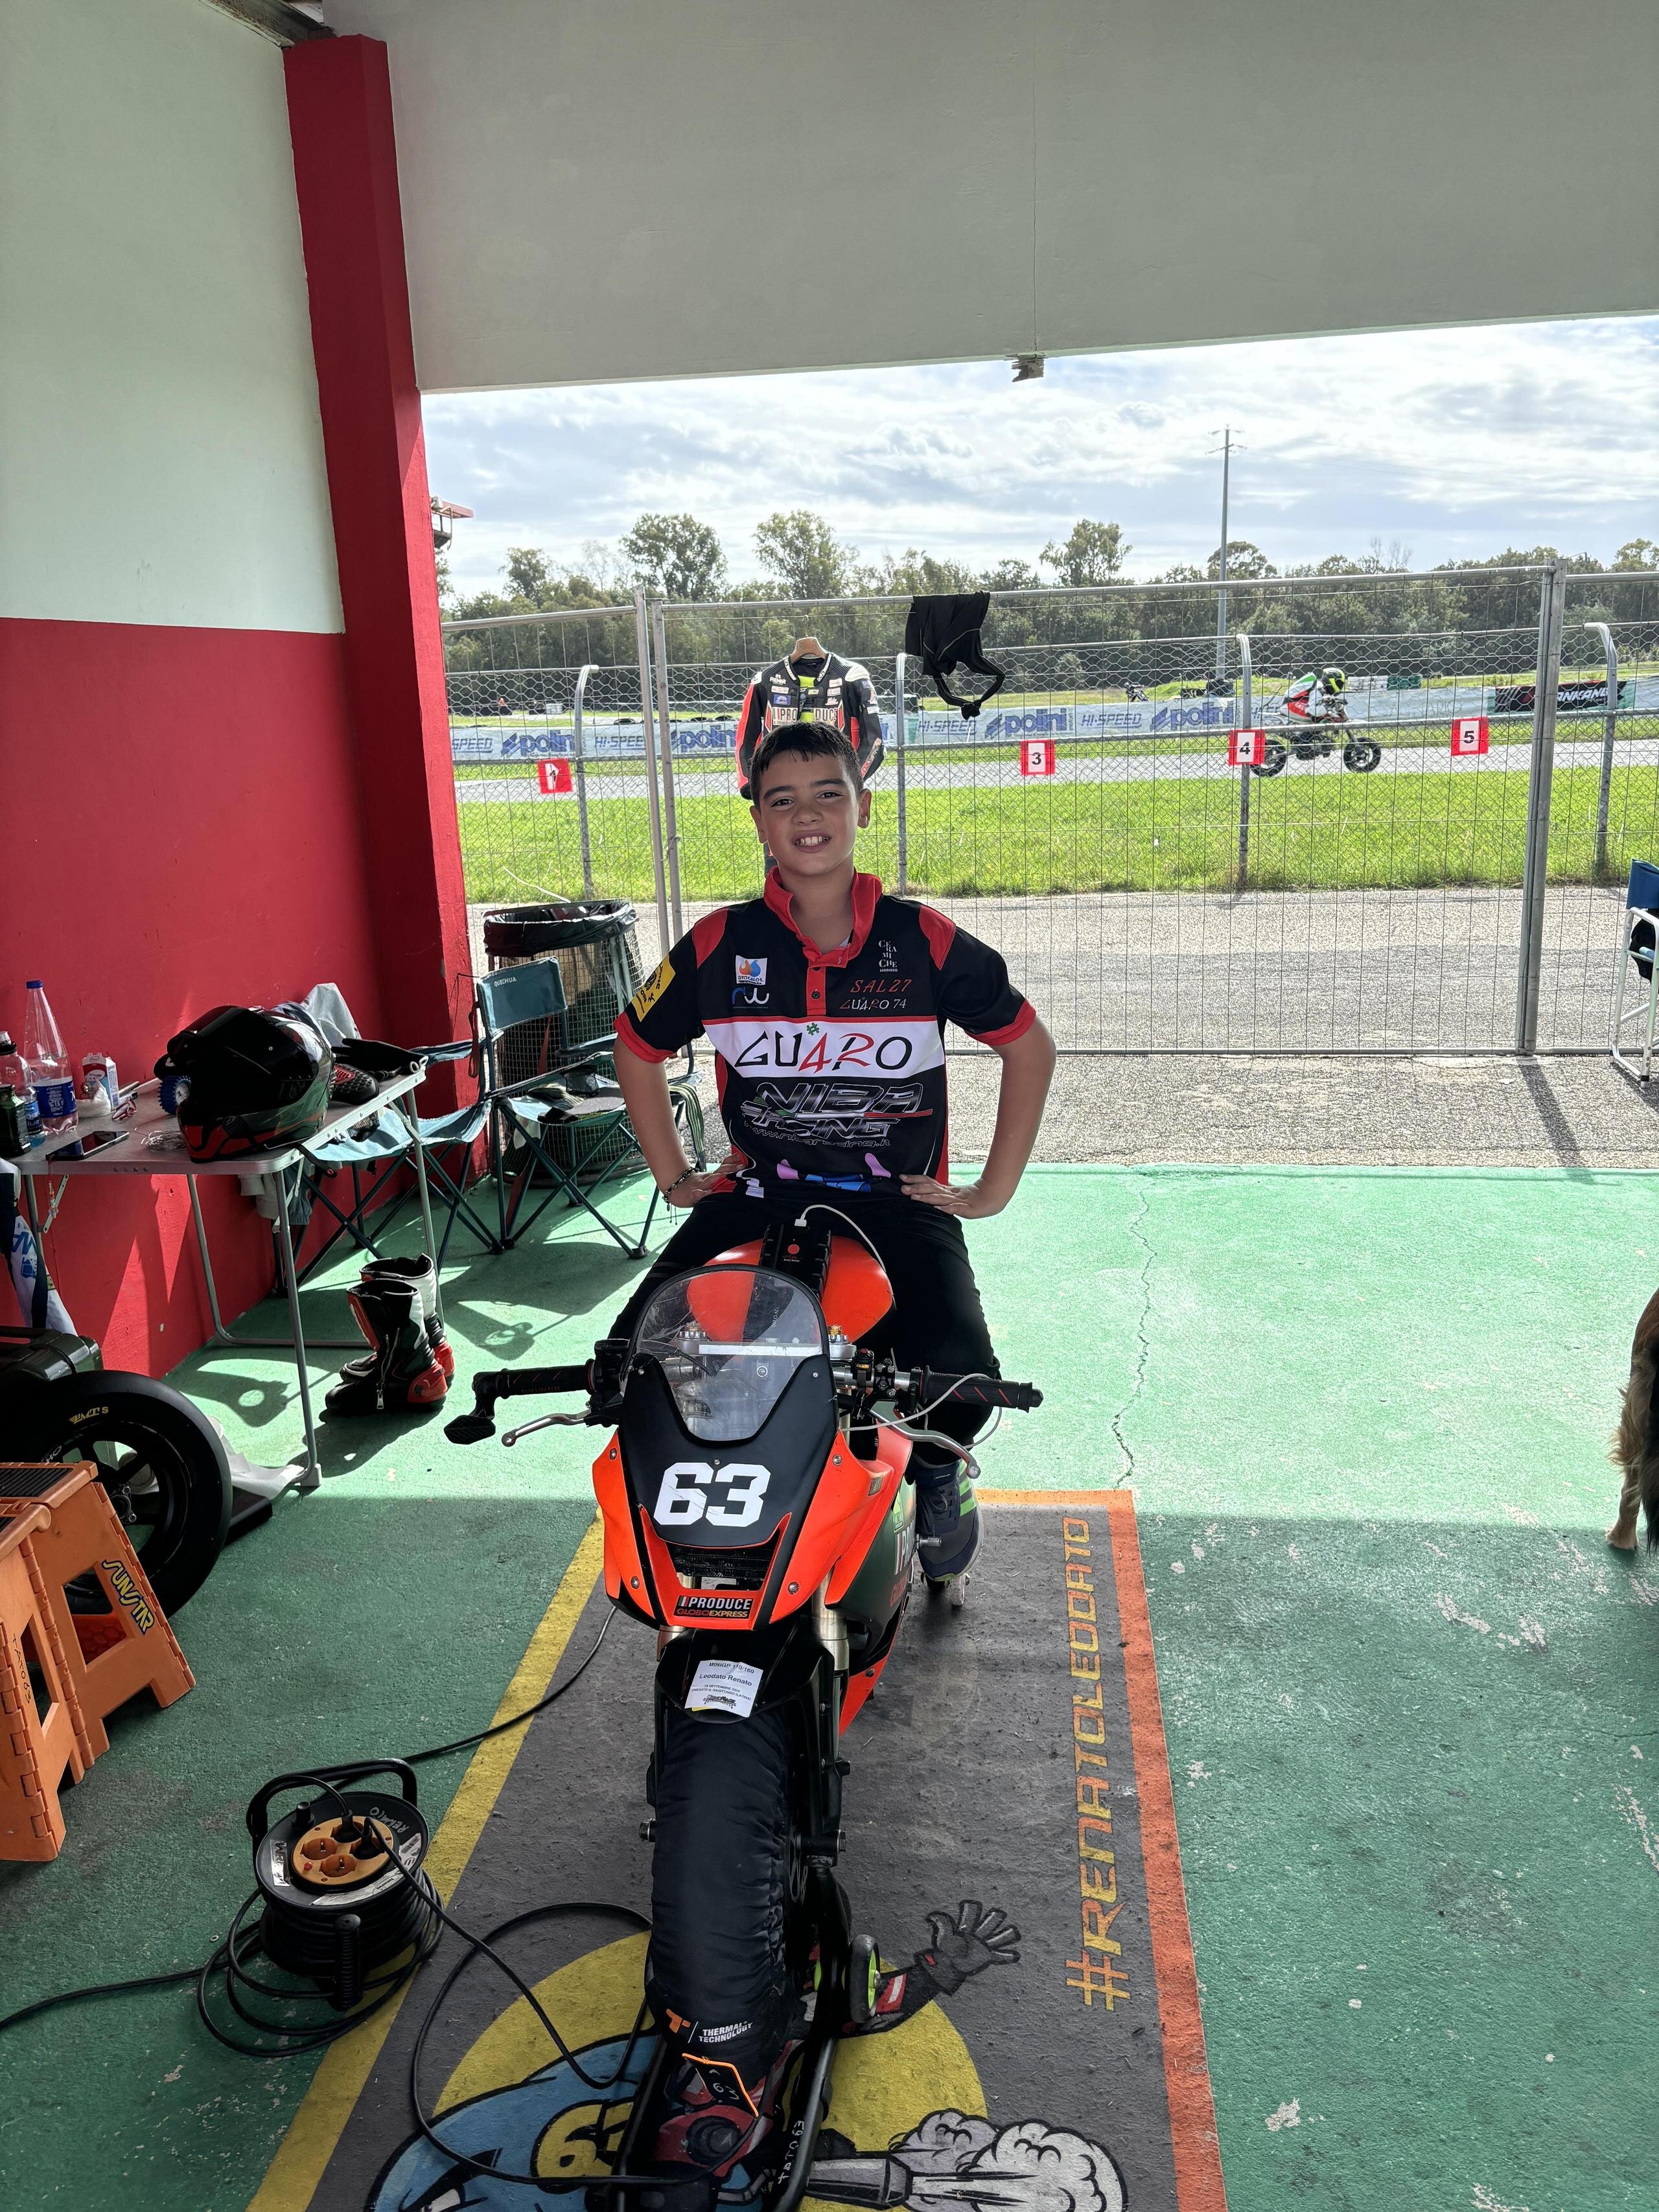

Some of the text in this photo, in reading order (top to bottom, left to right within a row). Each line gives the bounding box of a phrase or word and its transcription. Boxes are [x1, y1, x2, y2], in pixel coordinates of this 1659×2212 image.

[1004, 708, 1067, 734] polini
[1170, 701, 1234, 731] polini
[452, 737, 493, 751] SPEED
[519, 730, 576, 757] polin
[680, 725, 737, 753] polin
[1463, 730, 1474, 743] 5
[1239, 741, 1251, 754] 4
[1031, 752, 1041, 765] 3
[494, 977, 517, 987] QUECHUA
[893, 999, 907, 1009] 74
[756, 1082, 924, 1113] NIBA
[653, 1462, 771, 1527] 63
[102, 1559, 155, 1635] SUNSTAR
[728, 1675, 752, 1686] Renato
[699, 2021, 754, 2043] TECHNOLOGY
[702, 2022, 745, 2036] THERMAL
